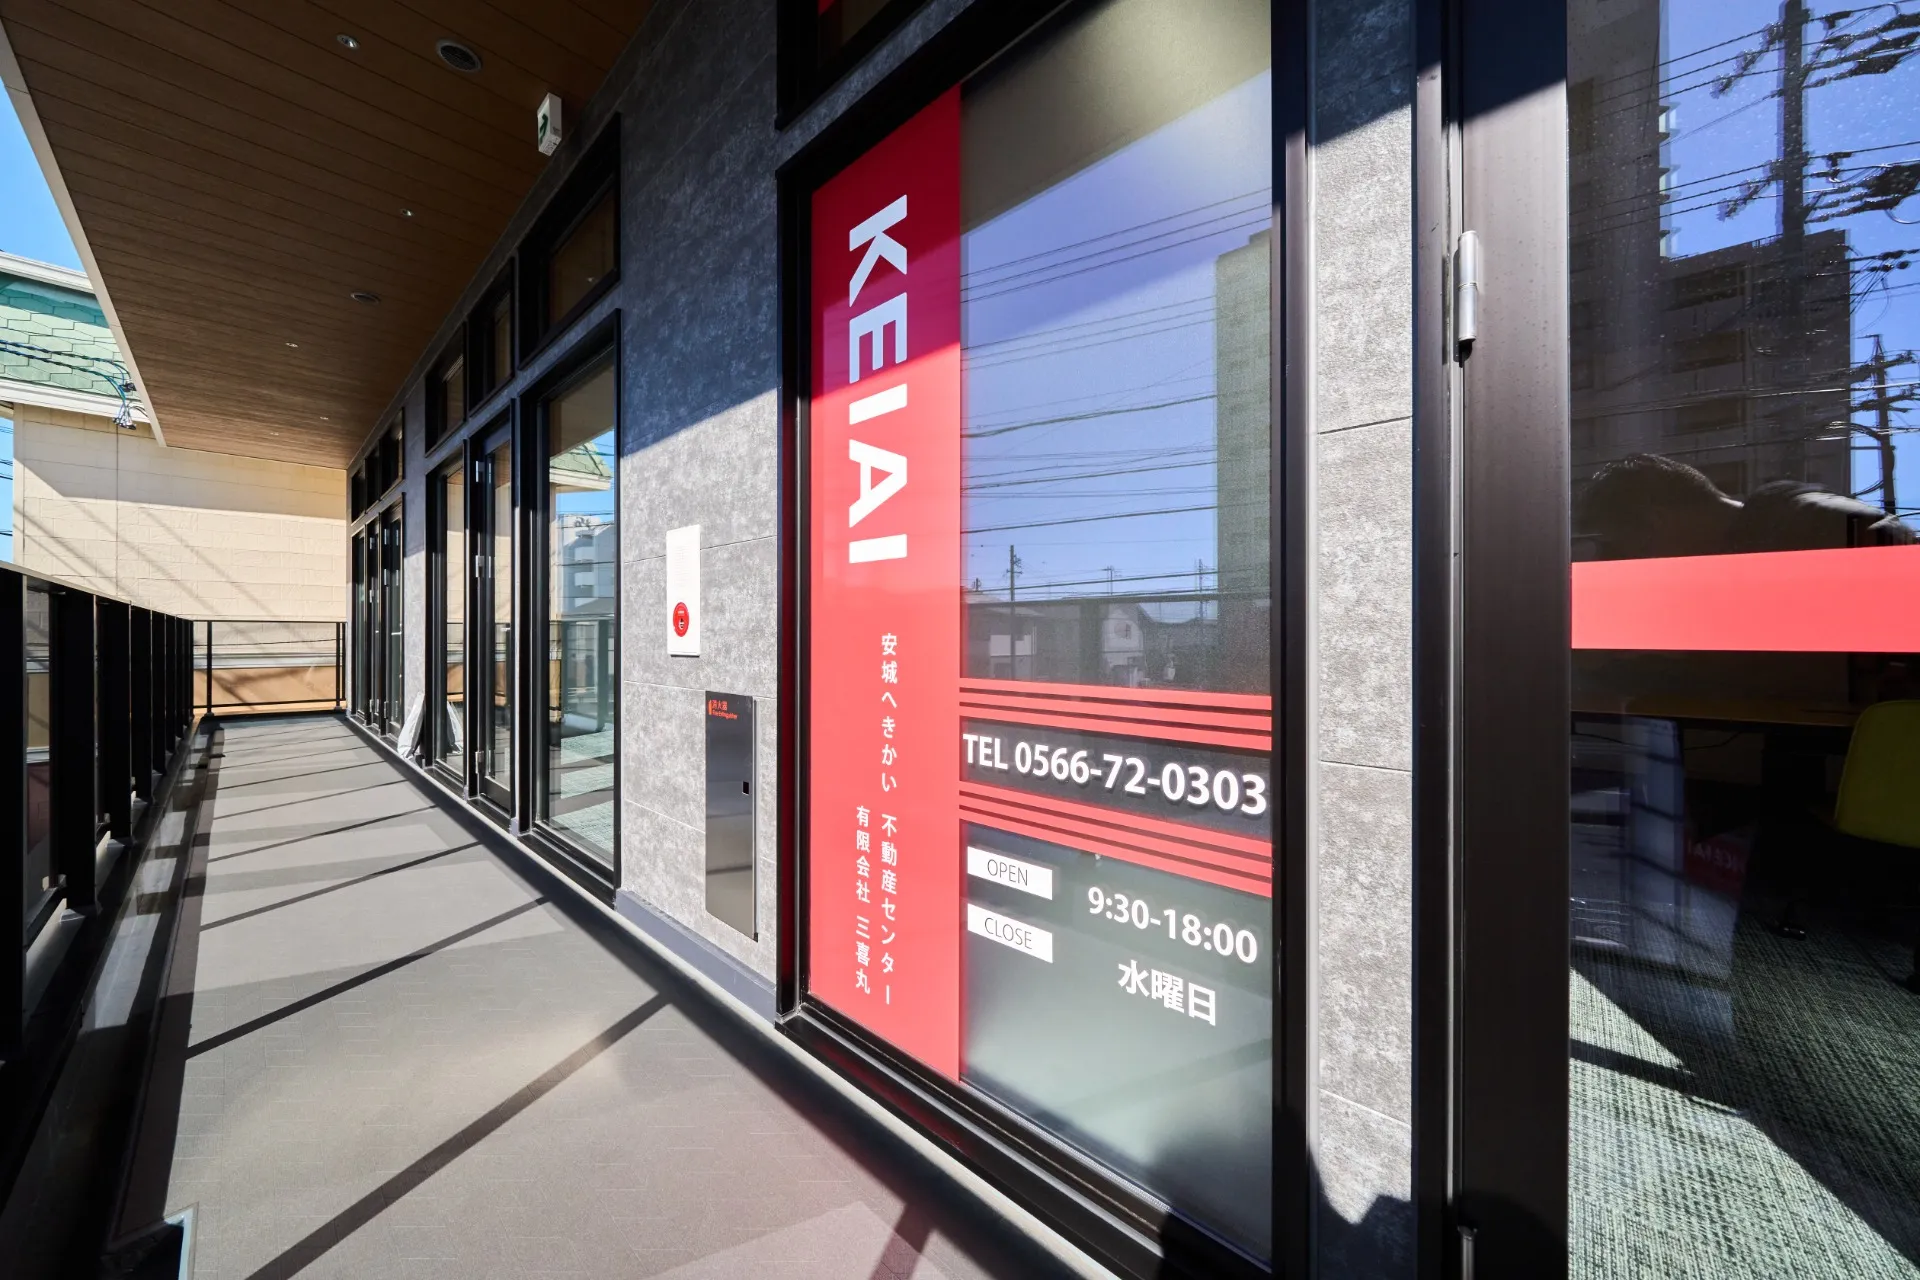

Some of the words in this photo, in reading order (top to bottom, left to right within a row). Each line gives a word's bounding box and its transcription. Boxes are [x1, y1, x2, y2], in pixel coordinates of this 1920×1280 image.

[849, 194, 908, 564] KEIAI
[881, 632, 898, 792] 安城へきかい
[962, 733, 1009, 770] TEL
[1015, 741, 1267, 815] 0566-72-0303
[855, 806, 871, 904] 有限会社
[987, 859, 1028, 887] OPEN
[881, 813, 898, 1005] 不動産センター
[984, 916, 1033, 950] CLOSE
[1087, 886, 1258, 964] 9:30-18:00
[855, 915, 871, 995] 三喜丸
[1117, 959, 1218, 1026] 水曜日
